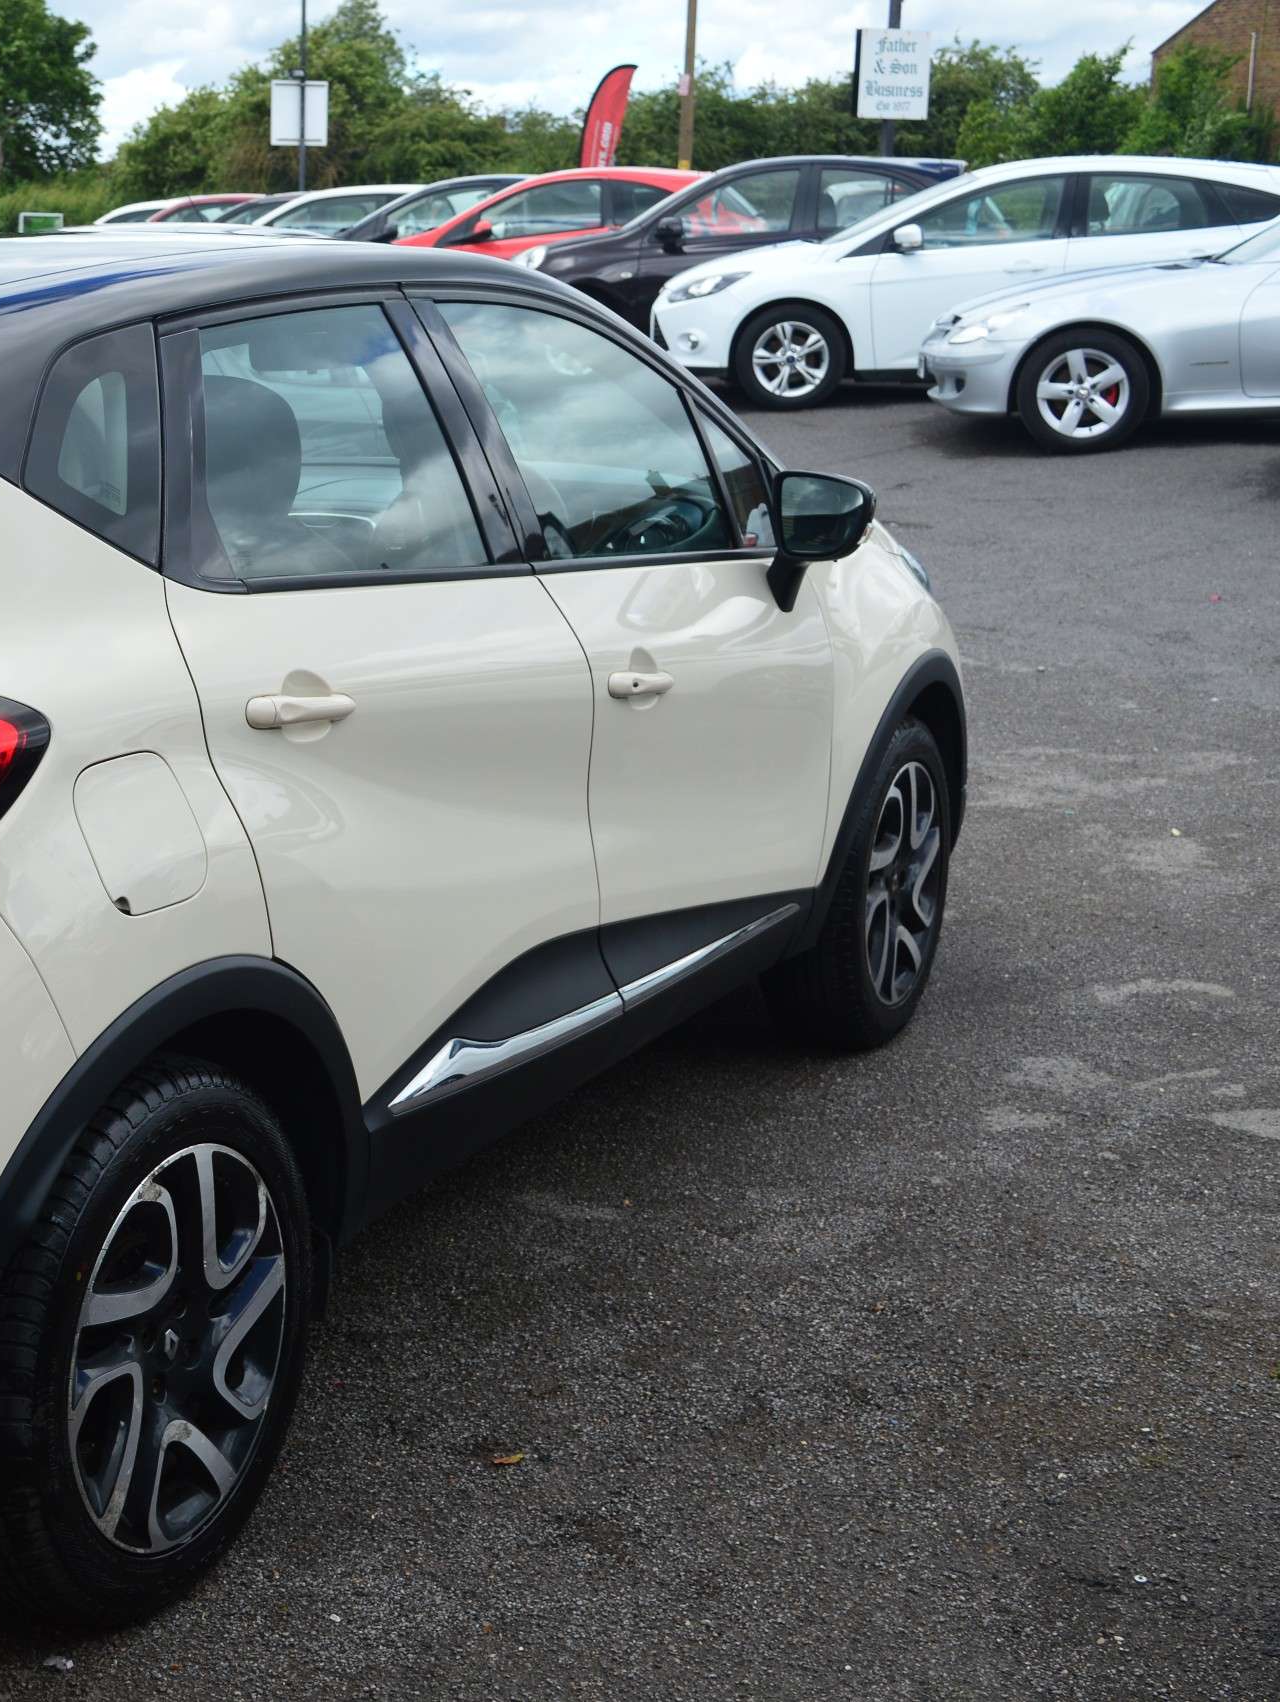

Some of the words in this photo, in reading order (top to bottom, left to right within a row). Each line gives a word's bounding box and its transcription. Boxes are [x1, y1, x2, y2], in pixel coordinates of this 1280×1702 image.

[874, 36, 917, 54] Father
[874, 59, 886, 74] &
[889, 59, 918, 74] Son
[864, 80, 924, 97] Business
